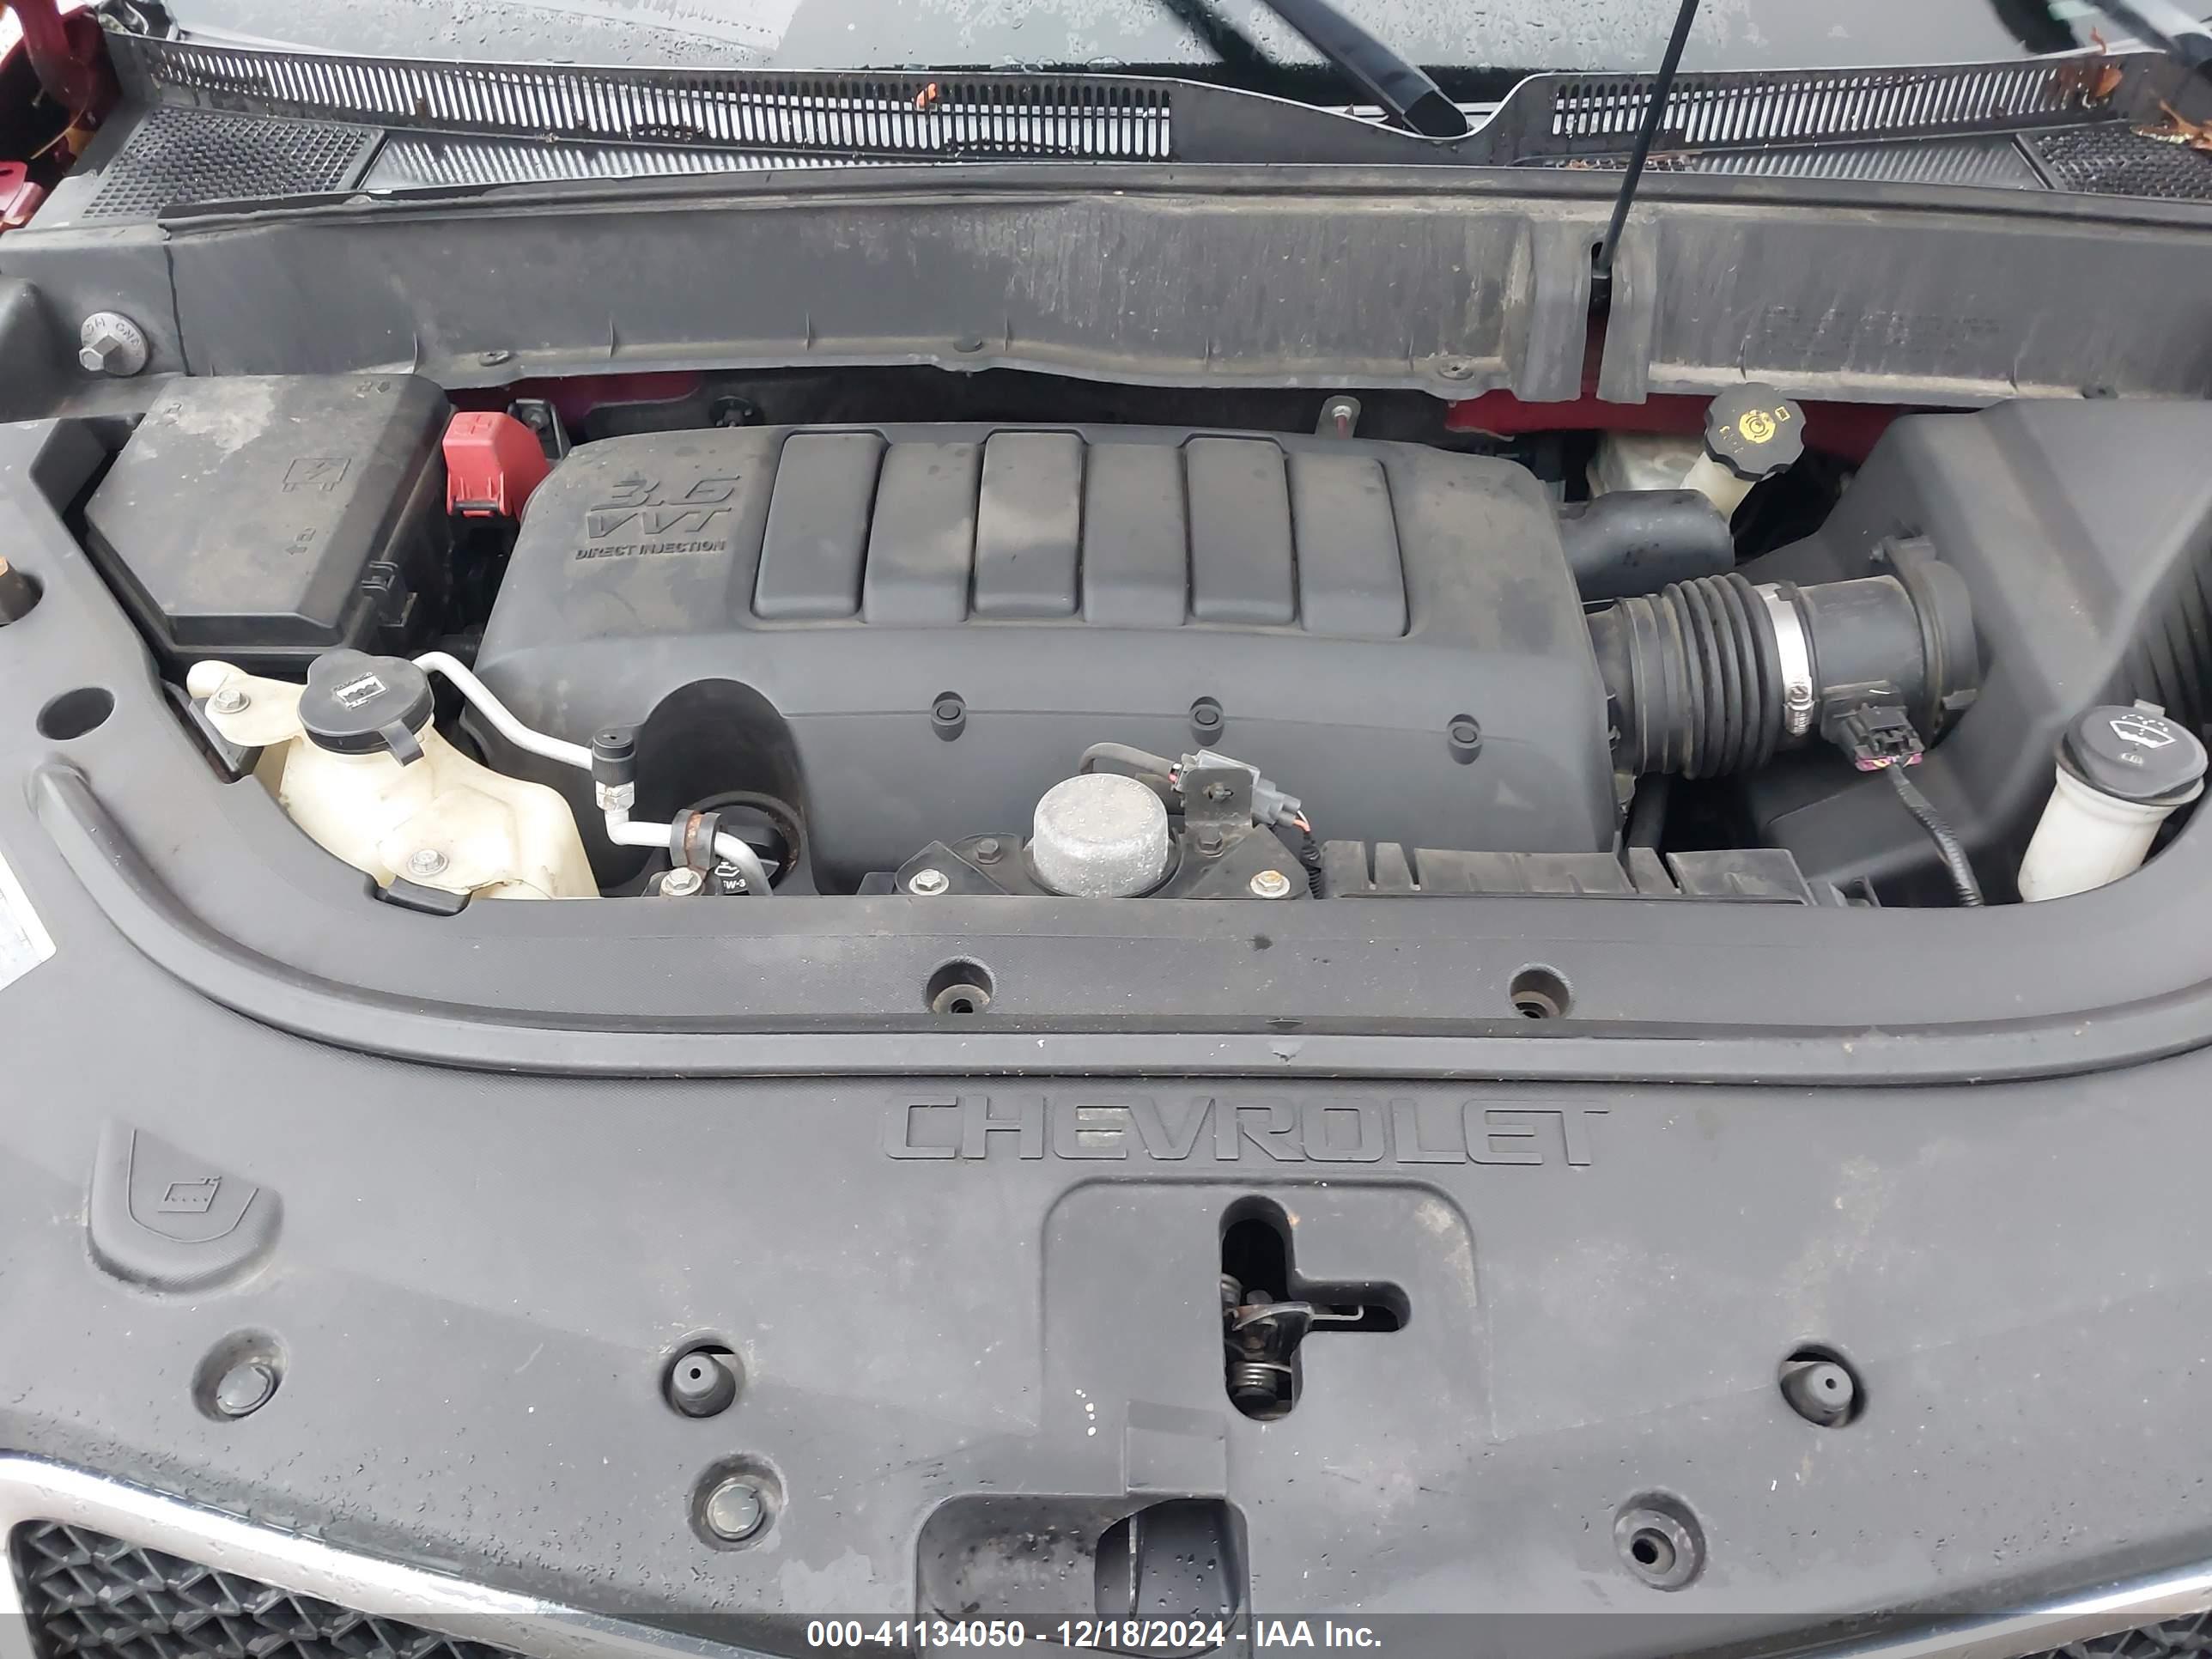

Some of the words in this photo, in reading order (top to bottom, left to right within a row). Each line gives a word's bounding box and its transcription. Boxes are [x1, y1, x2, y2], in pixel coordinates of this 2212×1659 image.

[590, 472, 741, 512] 3.6
[586, 507, 732, 540] VVT
[574, 543, 638, 561] DIRECT
[639, 539, 728, 556] INJECTION
[883, 1094, 1611, 1167] CHEVROLET
